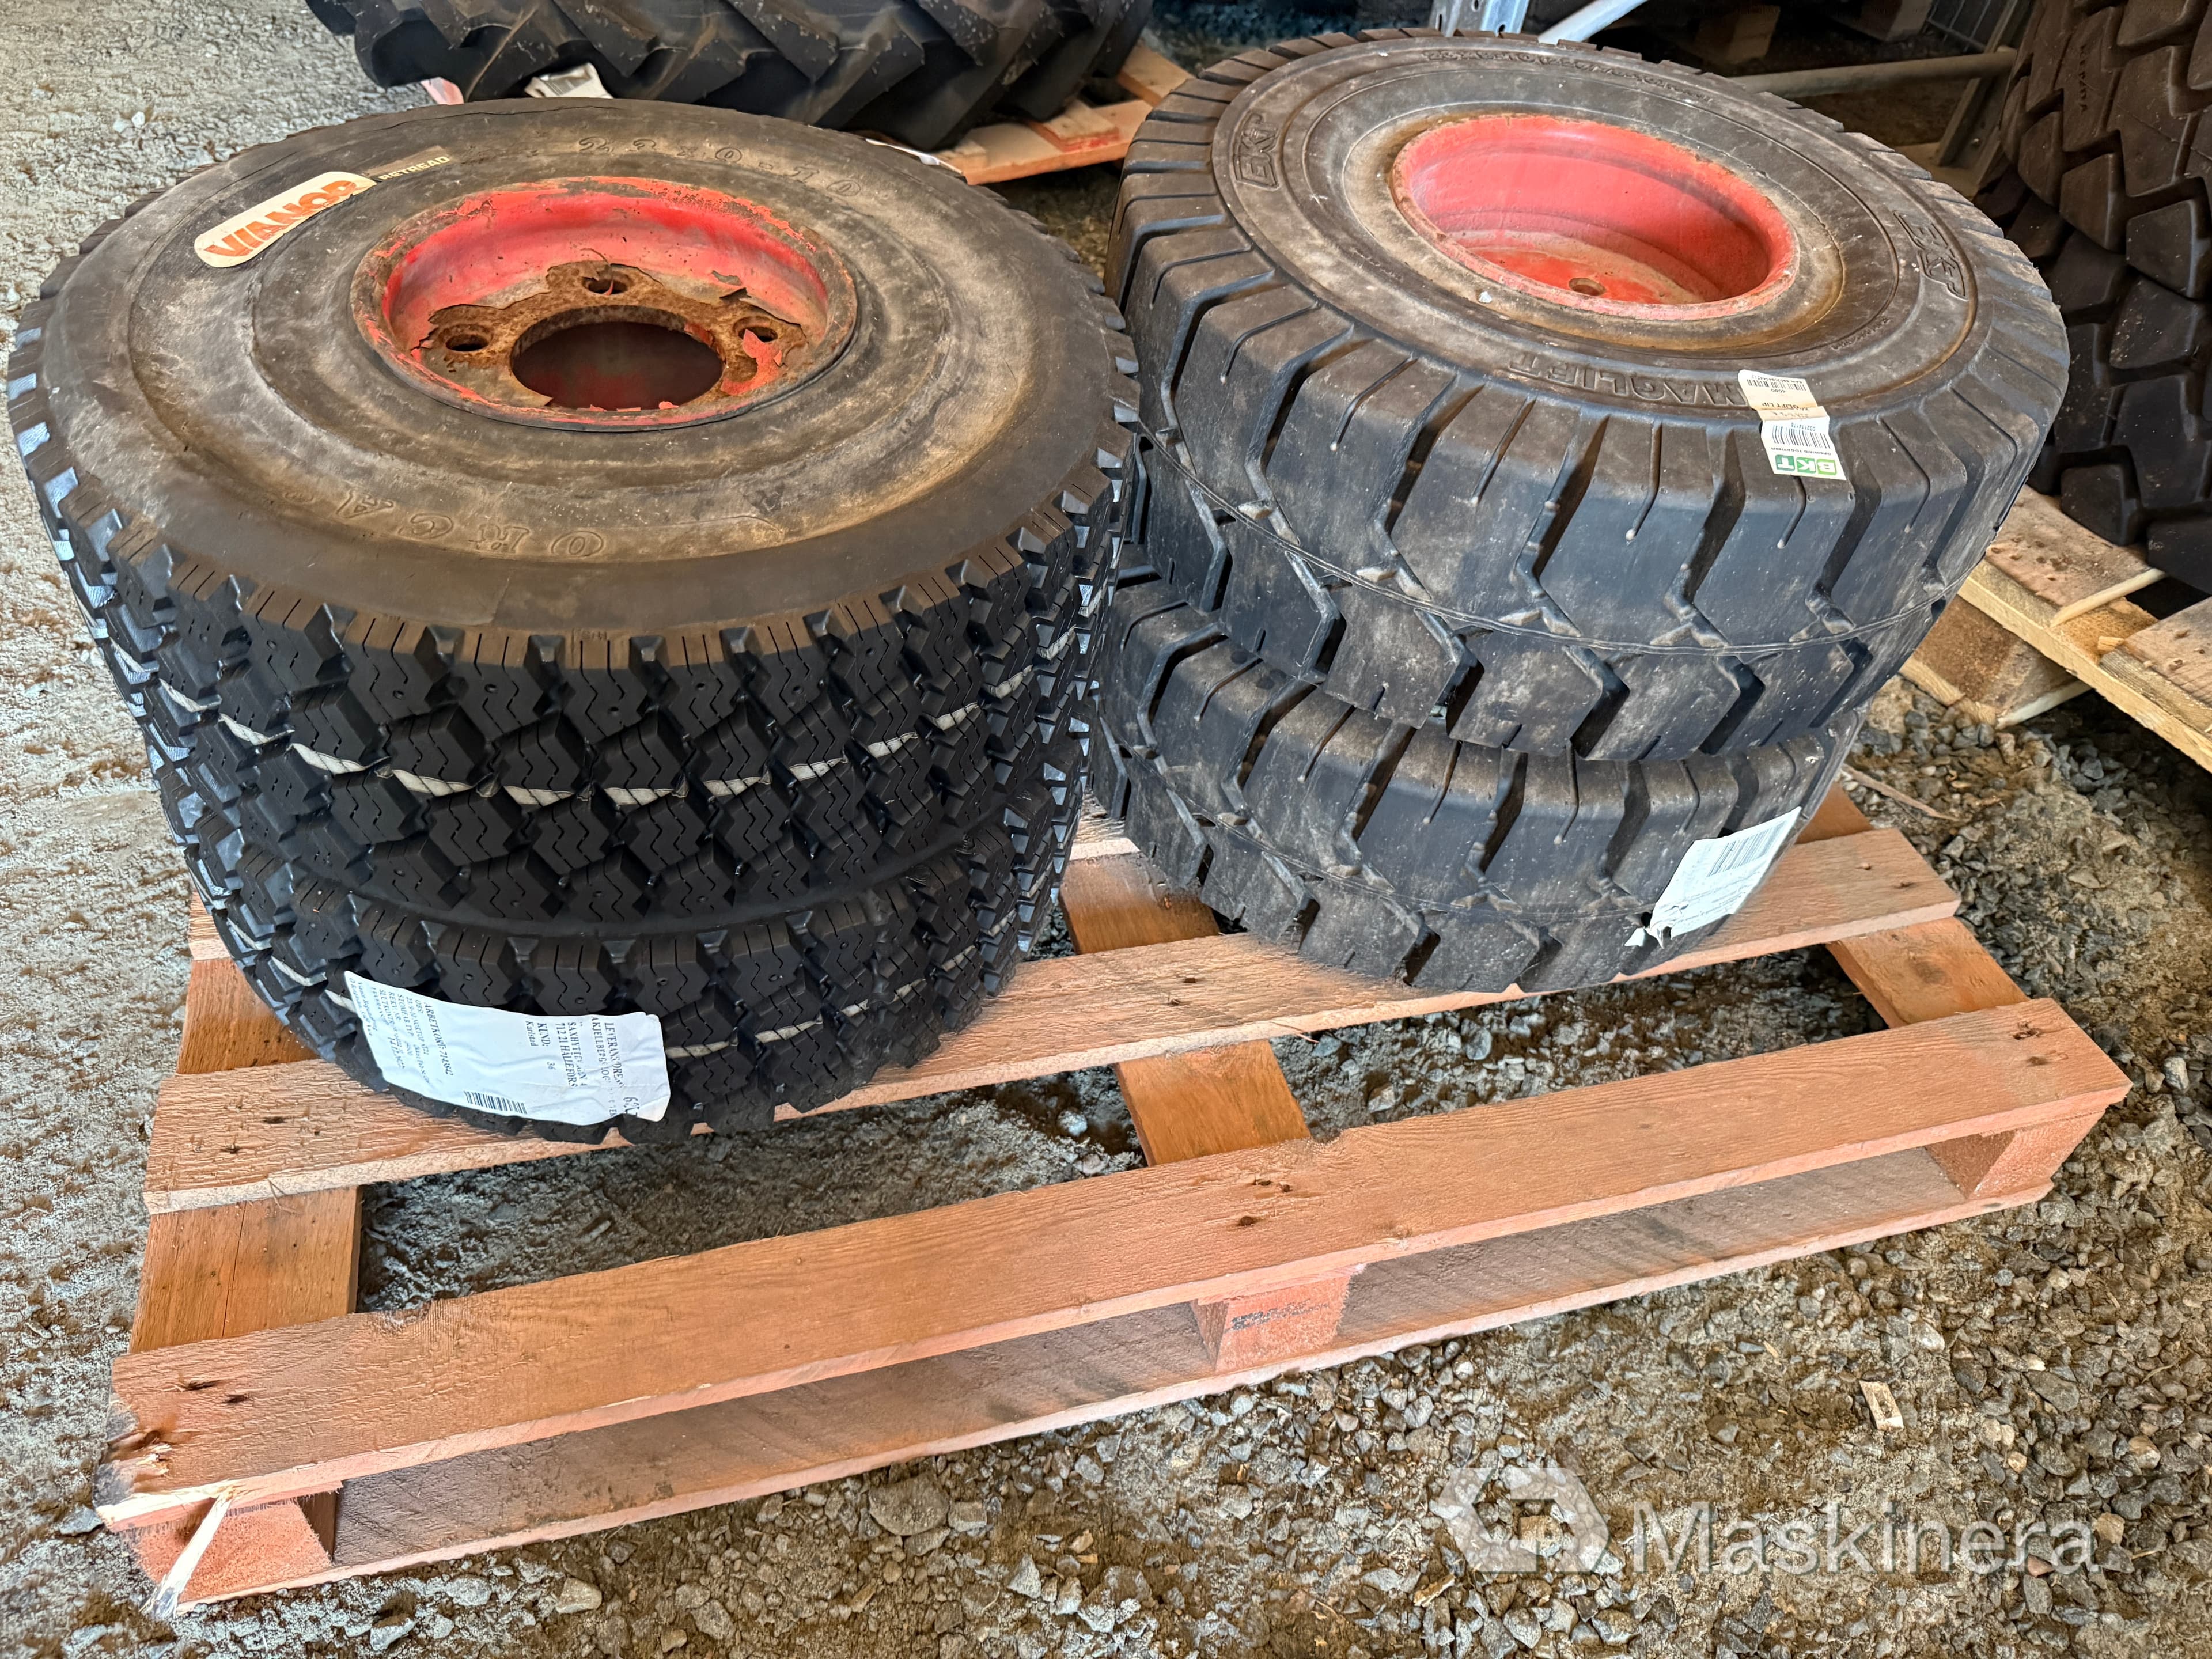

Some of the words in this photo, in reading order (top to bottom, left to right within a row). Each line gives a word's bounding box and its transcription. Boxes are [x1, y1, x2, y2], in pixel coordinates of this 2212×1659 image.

[378, 155, 450, 181] RETREAD
[205, 180, 361, 256] VIANOR
[1508, 351, 1751, 406] MAGLIFT
[1775, 455, 1836, 475] BKT
[525, 1021, 538, 1047] Karlstad
[537, 1022, 551, 1047] KUND:
[556, 1023, 566, 1034] 712
